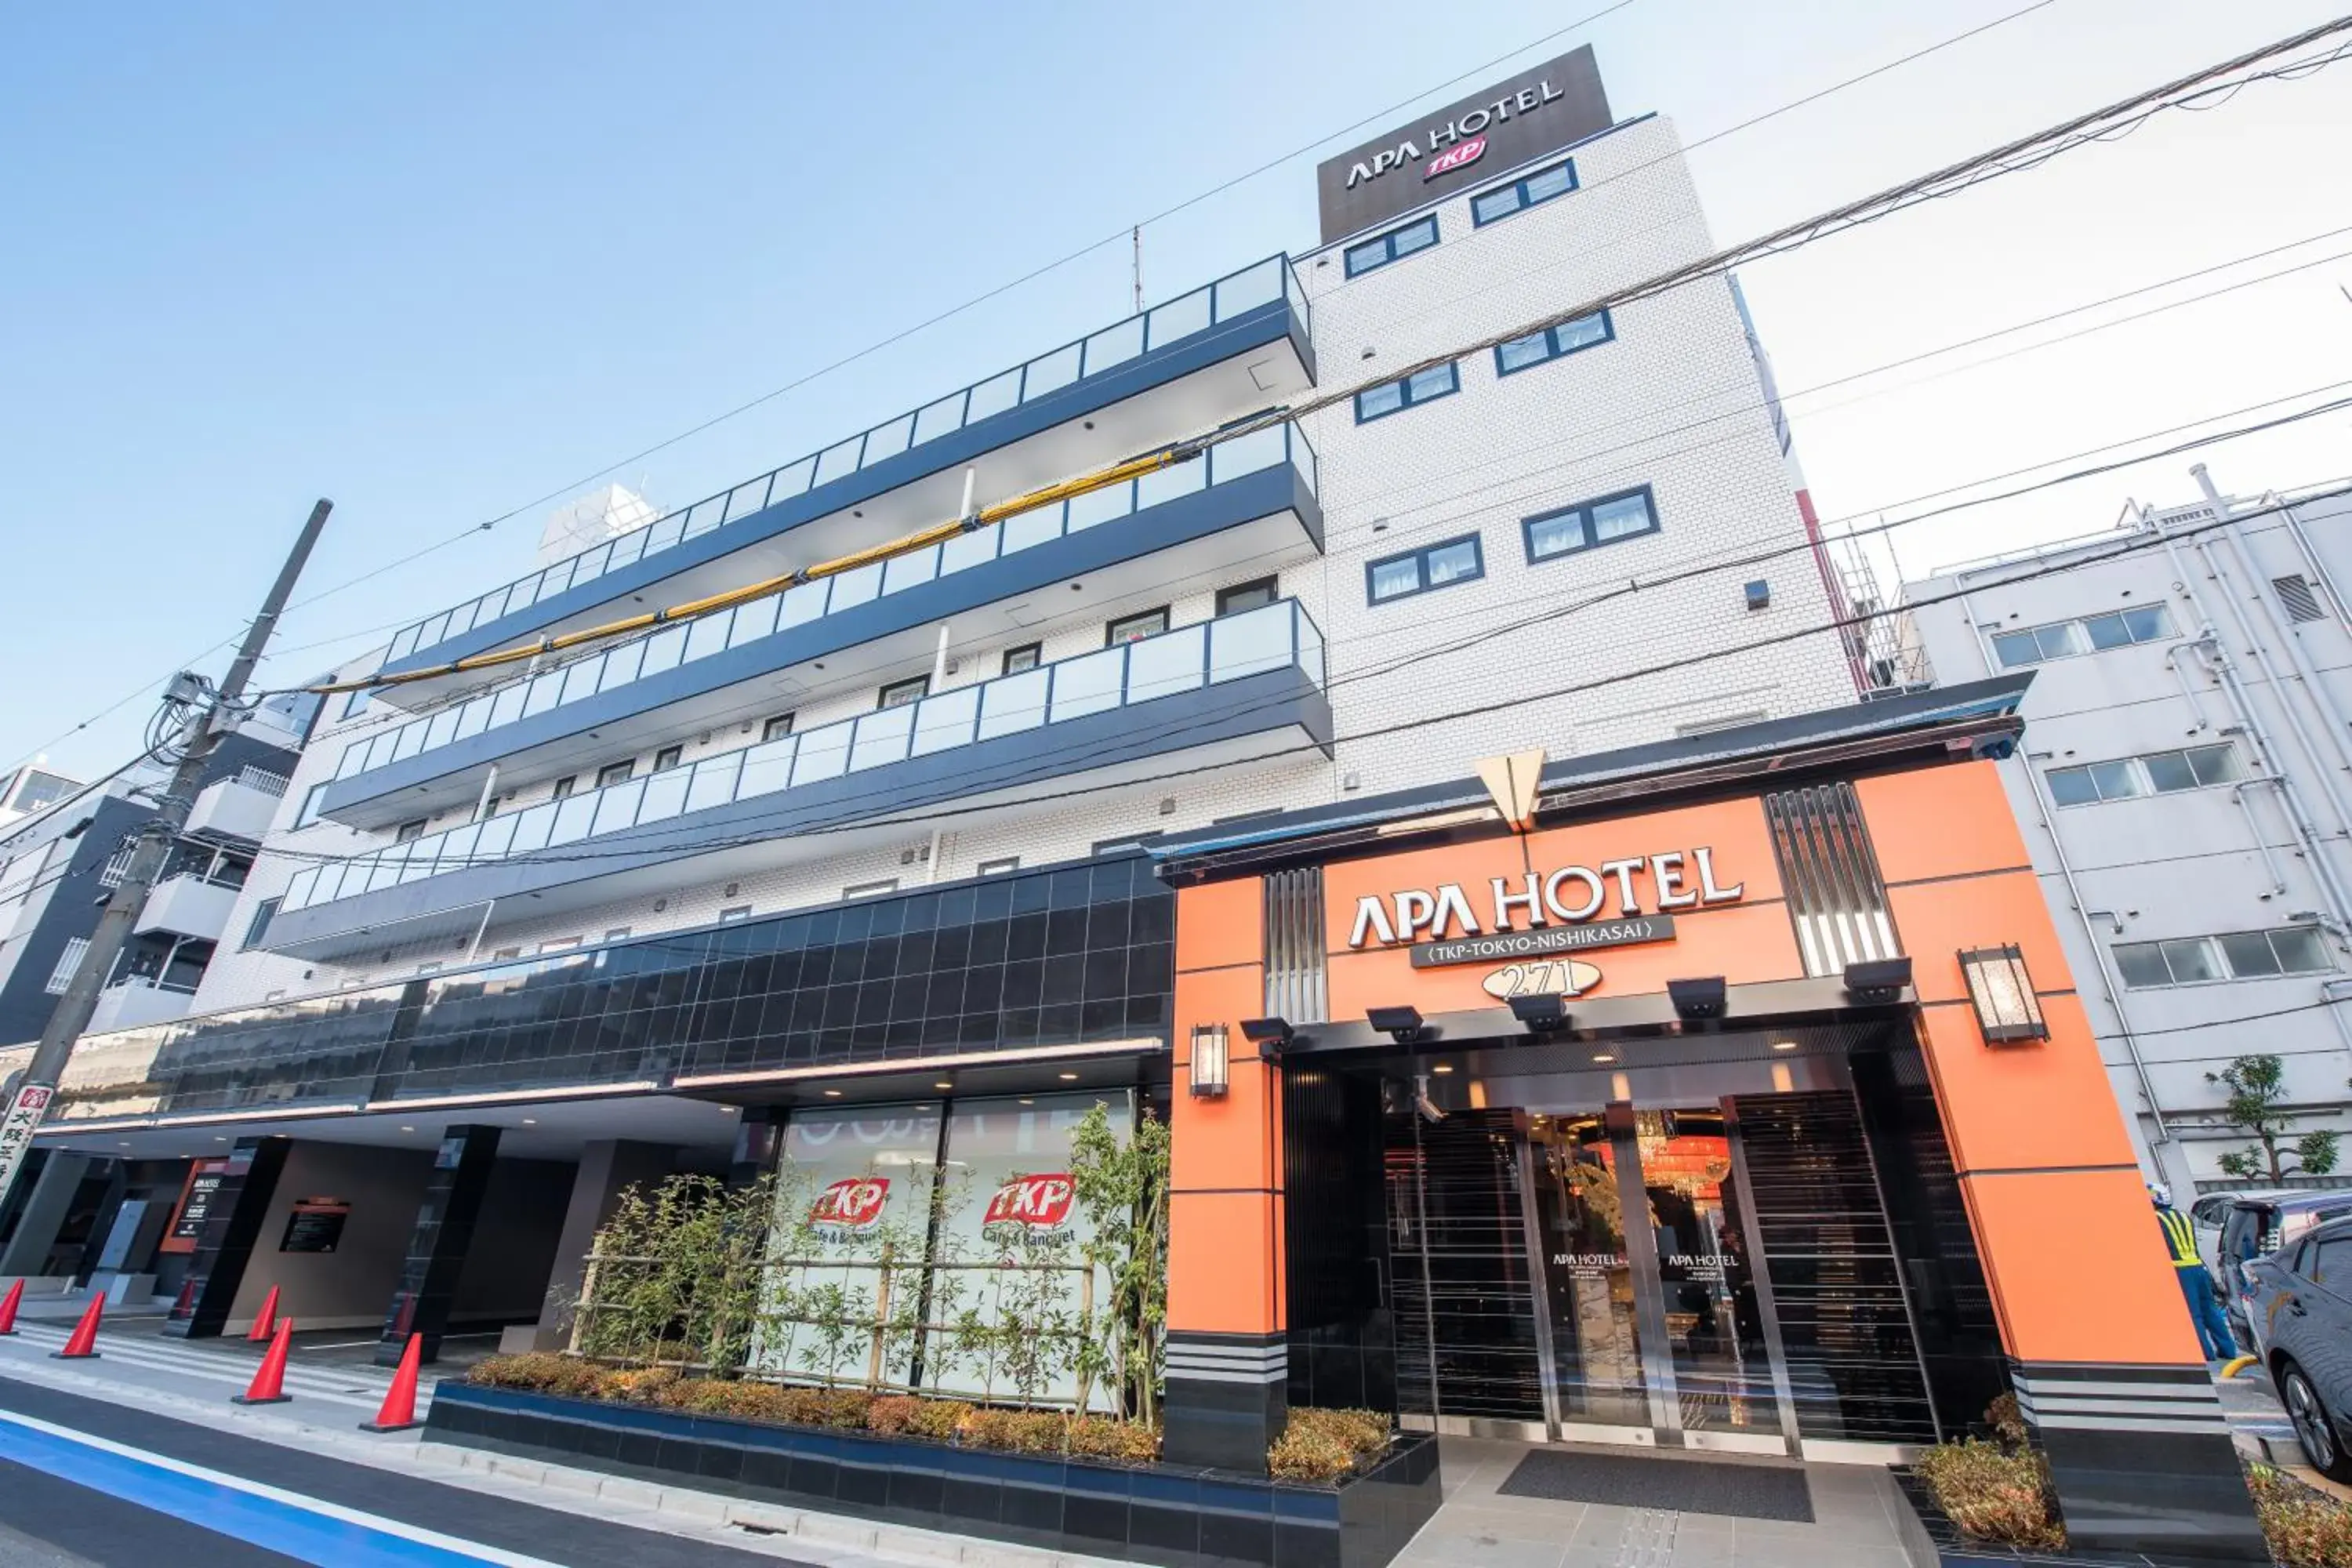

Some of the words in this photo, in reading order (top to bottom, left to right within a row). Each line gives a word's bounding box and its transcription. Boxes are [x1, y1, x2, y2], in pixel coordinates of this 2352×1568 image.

[1345, 140, 1423, 190] APA
[1428, 79, 1565, 153] HOTEL
[1426, 138, 1482, 175] TKP
[1348, 883, 1481, 949] APA
[1490, 847, 1745, 930] HOTEL
[1501, 958, 1581, 1001] 271
[991, 1179, 1072, 1217] TKP
[1552, 1254, 1577, 1265] APA
[1578, 1254, 1618, 1265] HOTEL
[1668, 1254, 1694, 1266] APA
[1695, 1254, 1740, 1267] HOTEL
